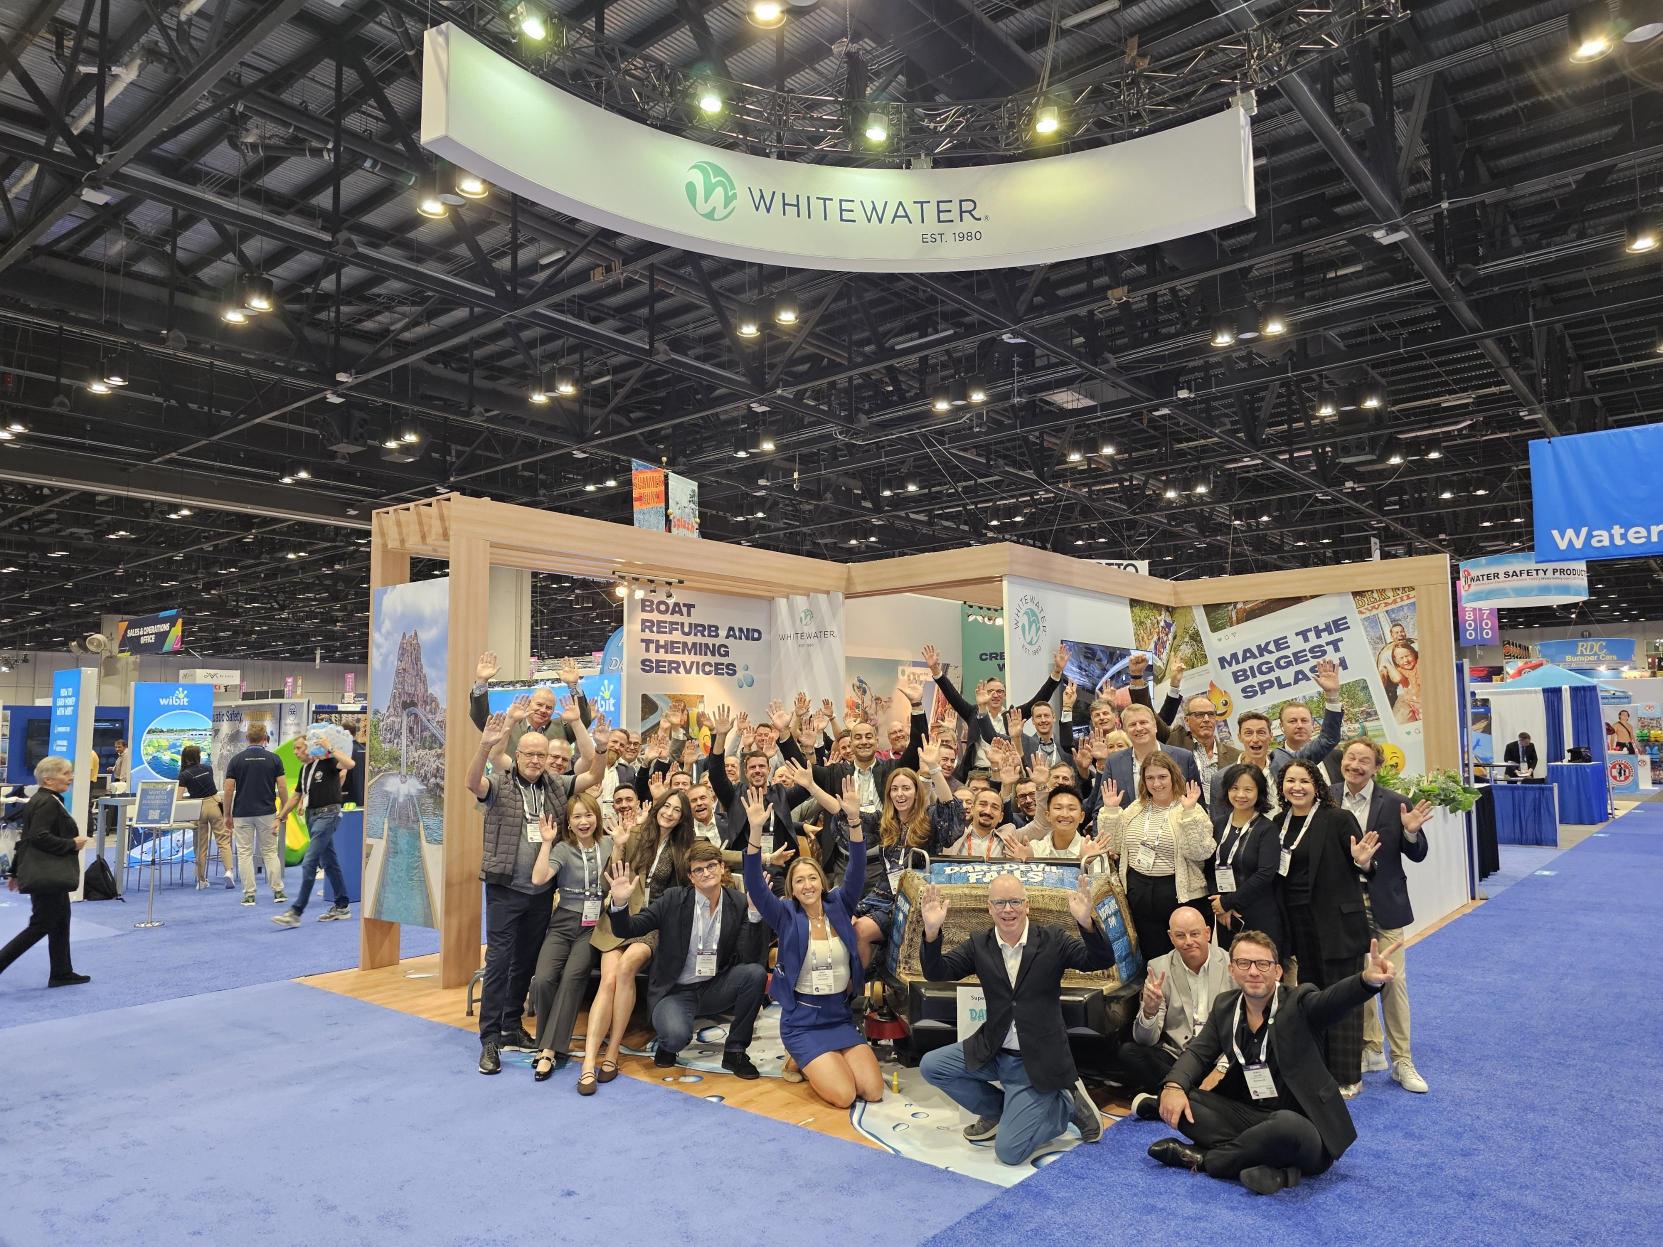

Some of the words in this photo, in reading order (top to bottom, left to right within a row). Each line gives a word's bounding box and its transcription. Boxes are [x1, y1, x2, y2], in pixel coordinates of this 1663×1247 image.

[921, 232, 948, 244] EST.
[952, 230, 983, 243] 1980
[1550, 523, 1663, 551] Water
[1470, 572, 1500, 583] WATER
[1503, 568, 1549, 579] SAFETY
[640, 598, 695, 618] BOAT
[640, 618, 720, 639] REFURB
[724, 626, 762, 642] AND
[1465, 607, 1476, 640] 800
[1481, 607, 1492, 639] 700
[640, 638, 730, 659] THEMING
[1217, 635, 1291, 671] MAKE
[1294, 615, 1351, 644] THE
[640, 658, 737, 677] SERVICES
[1231, 637, 1345, 685] BIGGEST
[1565, 655, 1598, 663] Bumper
[159, 691, 188, 706] wibit
[595, 695, 617, 711] ibit
[943, 863, 1063, 874] DAREDEVIL
